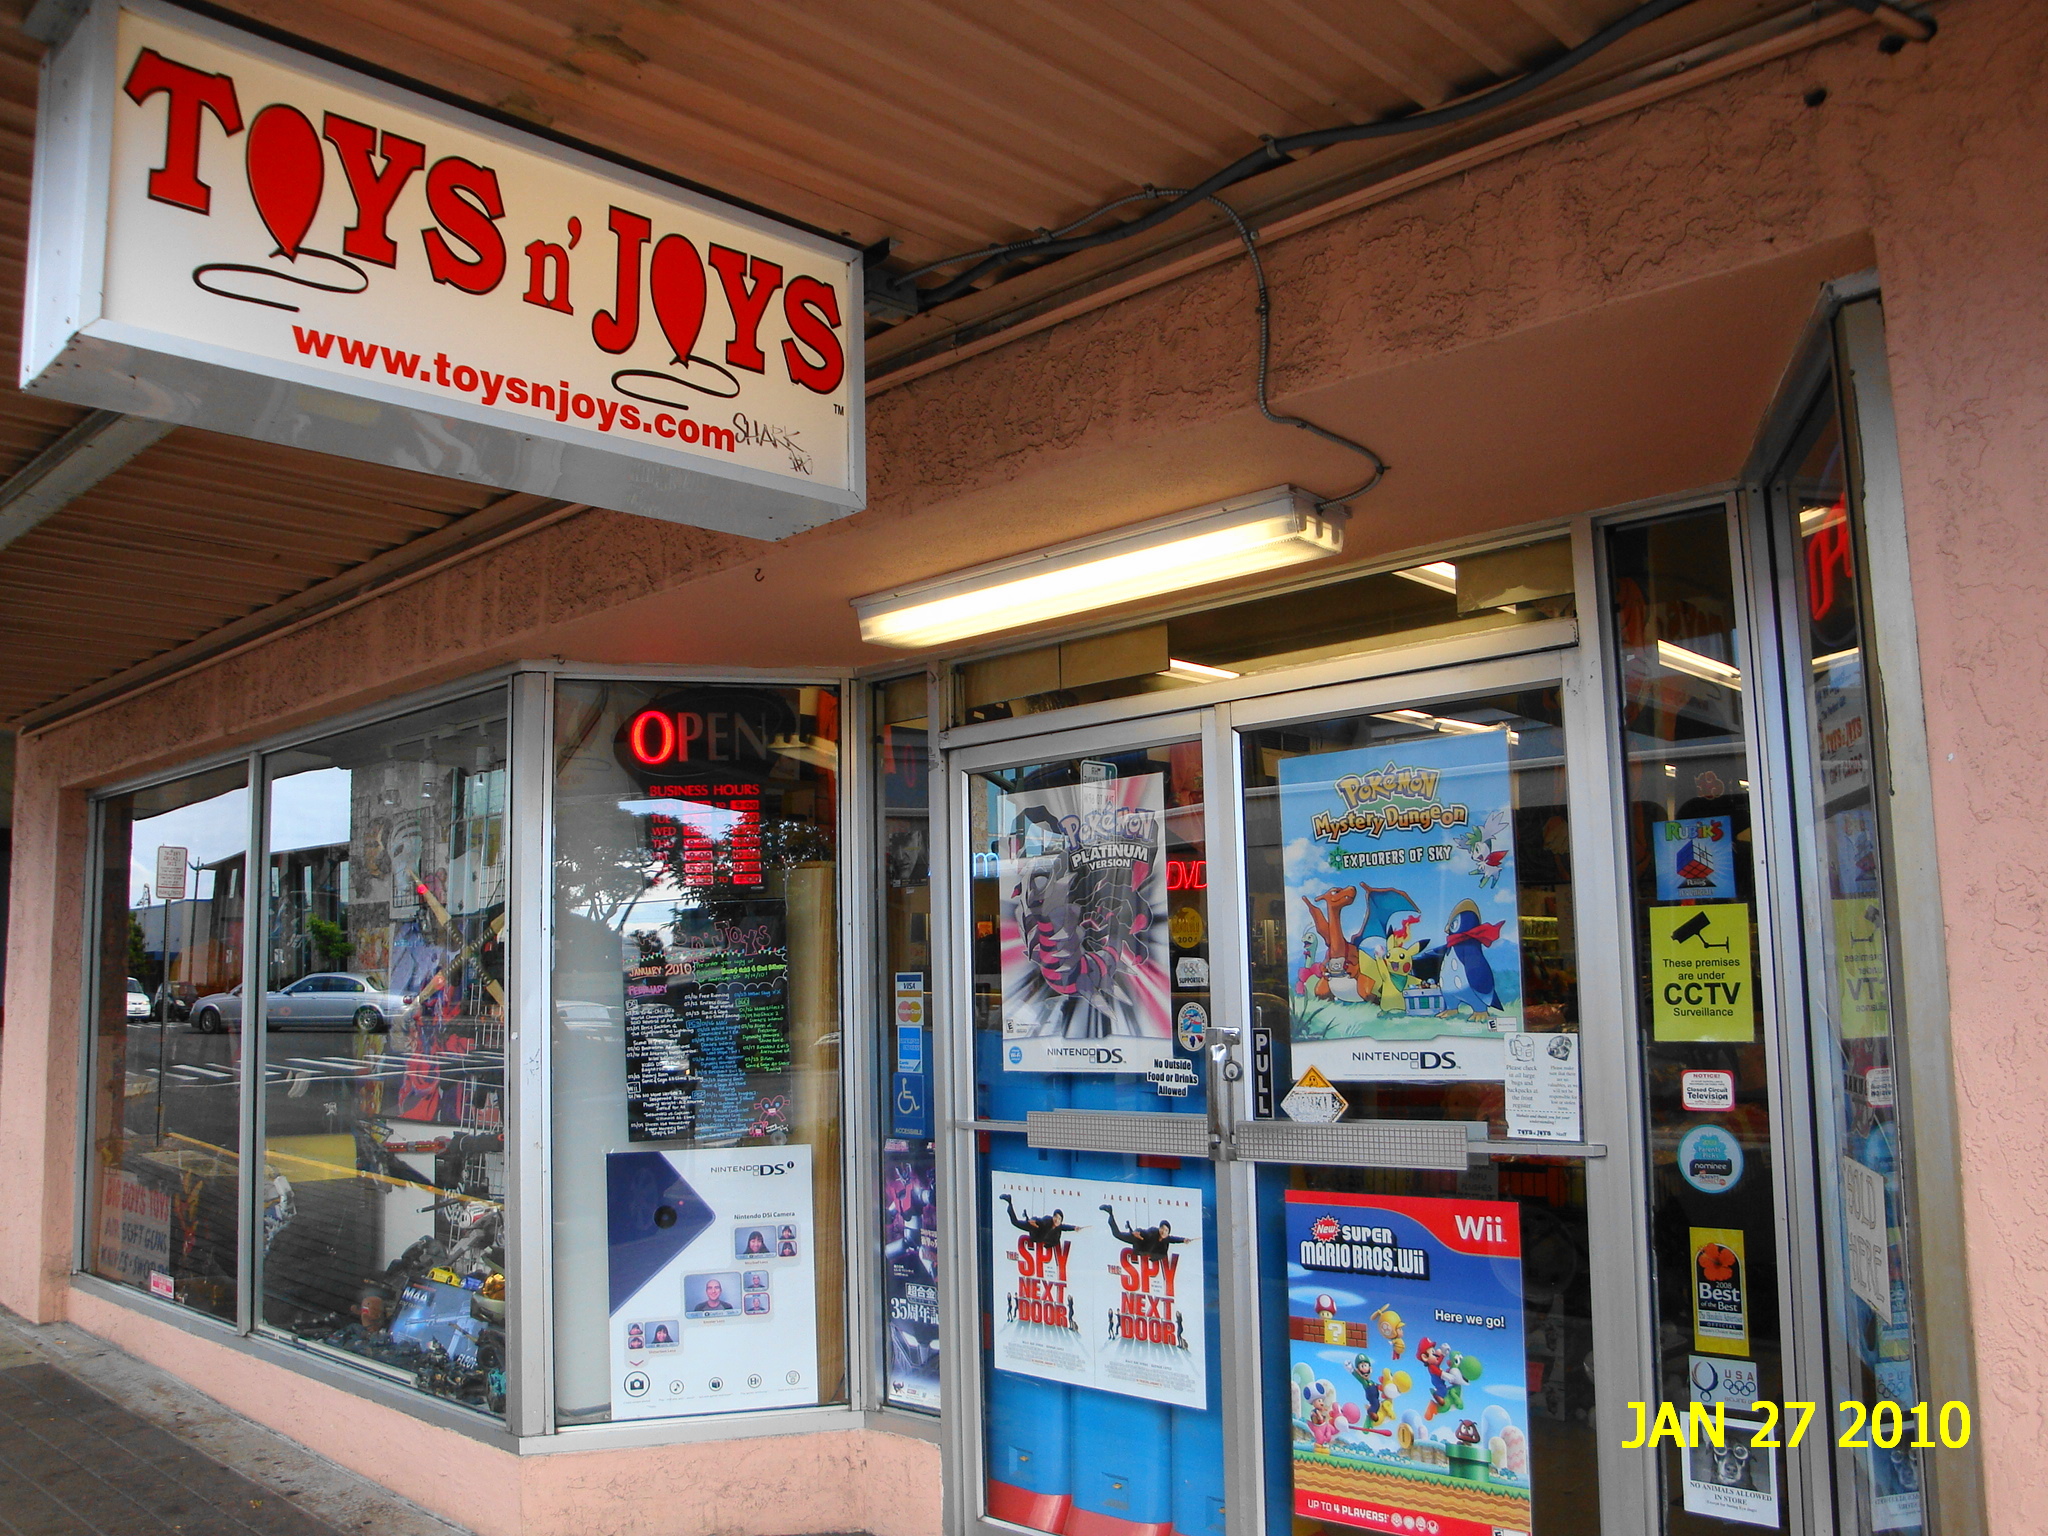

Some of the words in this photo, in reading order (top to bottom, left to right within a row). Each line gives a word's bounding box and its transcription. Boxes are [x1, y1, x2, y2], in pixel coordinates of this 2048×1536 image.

[124, 47, 507, 296] TOYS
[592, 205, 845, 395] JOYS
[292, 324, 736, 453] www.toysnjoys.com
[631, 710, 768, 765] OPEN
[649, 785, 708, 797] BUSINESS
[713, 784, 760, 796] HOURS
[651, 827, 677, 837] WED
[1313, 809, 1386, 842] Mystery
[1383, 804, 1467, 831] Dungeon
[1071, 844, 1148, 868] PLATINUM
[1089, 859, 1131, 871] VERSION
[1343, 851, 1405, 869] EXPLORERS
[1409, 848, 1423, 862] OF
[1428, 845, 1453, 861] SKY
[629, 967, 662, 978] JANUARY
[665, 963, 692, 977] 2010
[1663, 958, 1692, 968] These
[1695, 957, 1740, 970] premises
[1677, 972, 1694, 981] are
[1697, 971, 1725, 980] under
[1663, 982, 1741, 1006] CCTV
[1673, 1007, 1734, 1017] Surveillance
[1047, 1047, 1096, 1056] NINTENDO
[1096, 1048, 1124, 1064] DS
[1154, 1059, 1164, 1069] No
[1164, 1059, 1192, 1070] Outside
[1352, 1050, 1419, 1062] NINTENDO
[1419, 1051, 1457, 1070] DS
[1148, 1072, 1165, 1082] Food
[1166, 1074, 1174, 1082] or
[1175, 1073, 1198, 1084] Drinks
[1255, 1034, 1270, 1116] PULL
[1158, 1086, 1187, 1097] Allowed
[1687, 1092, 1729, 1100] Television
[1003, 1183, 1044, 1194] JACKIE
[1053, 1188, 1082, 1197] CHAN
[1104, 1193, 1147, 1204] JACKIE
[1158, 1198, 1190, 1208] CHAN
[1316, 1224, 1336, 1235] New
[1341, 1225, 1393, 1244] SUPER
[1454, 1214, 1504, 1243] Wii
[1006, 1250, 1019, 1262] THE
[1017, 1234, 1071, 1282] SPY
[1300, 1240, 1351, 1268] MARIO
[1107, 1264, 1122, 1276] THE
[1119, 1247, 1180, 1297] SPY
[1018, 1276, 1067, 1303] NEXT
[1698, 1281, 1741, 1302] Best
[1716, 1281, 1733, 1290] 2008
[1017, 1298, 1068, 1328] DOOR
[1121, 1291, 1175, 1321] NEXT
[1718, 1301, 1738, 1312] Best
[1435, 1308, 1464, 1324] Here
[1465, 1313, 1484, 1326] we
[1485, 1316, 1506, 1329] go!
[1706, 1322, 1736, 1330] OFFICIAL
[1120, 1314, 1177, 1346] DOOR
[1724, 1368, 1755, 1382] USA
[1702, 1484, 1735, 1495] ANIMALS
[1736, 1491, 1772, 1502] ALLOWED
[1307, 1498, 1320, 1509] UP
[1320, 1501, 1332, 1512] TO
[1333, 1502, 1341, 1513] 4
